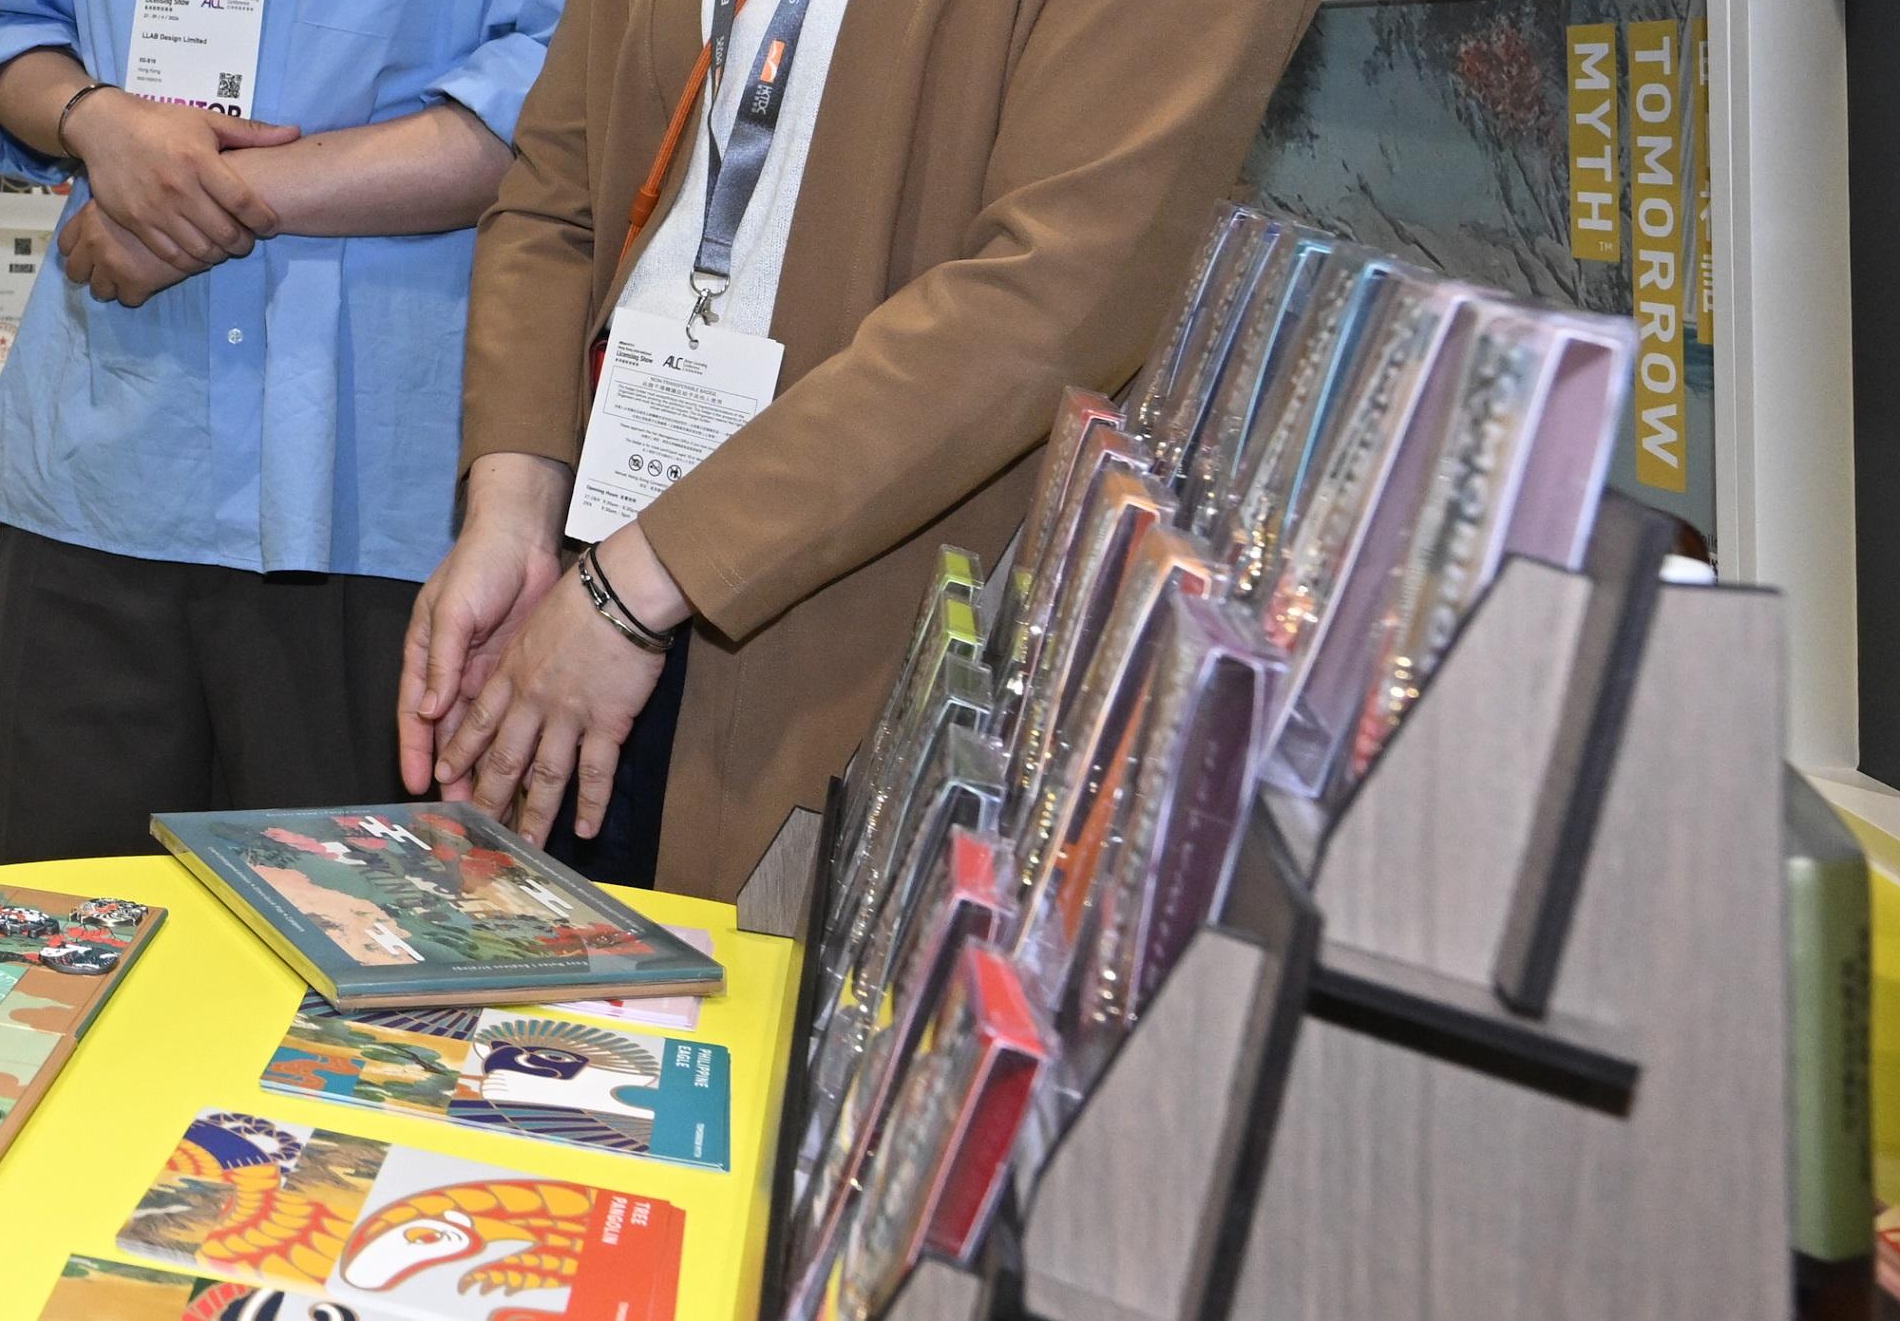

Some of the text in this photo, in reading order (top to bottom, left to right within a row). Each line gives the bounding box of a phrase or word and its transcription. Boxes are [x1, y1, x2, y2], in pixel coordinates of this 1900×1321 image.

[142, 31, 208, 45] LLAB Design Limited
[1573, 42, 1614, 232] MYTH
[1634, 35, 1679, 469] TOMORROW
[675, 1044, 693, 1069] EAGLE
[694, 1047, 713, 1089] PHILIPPINE
[601, 1195, 629, 1246] PANGOLIN
[629, 1201, 652, 1227] TREE
